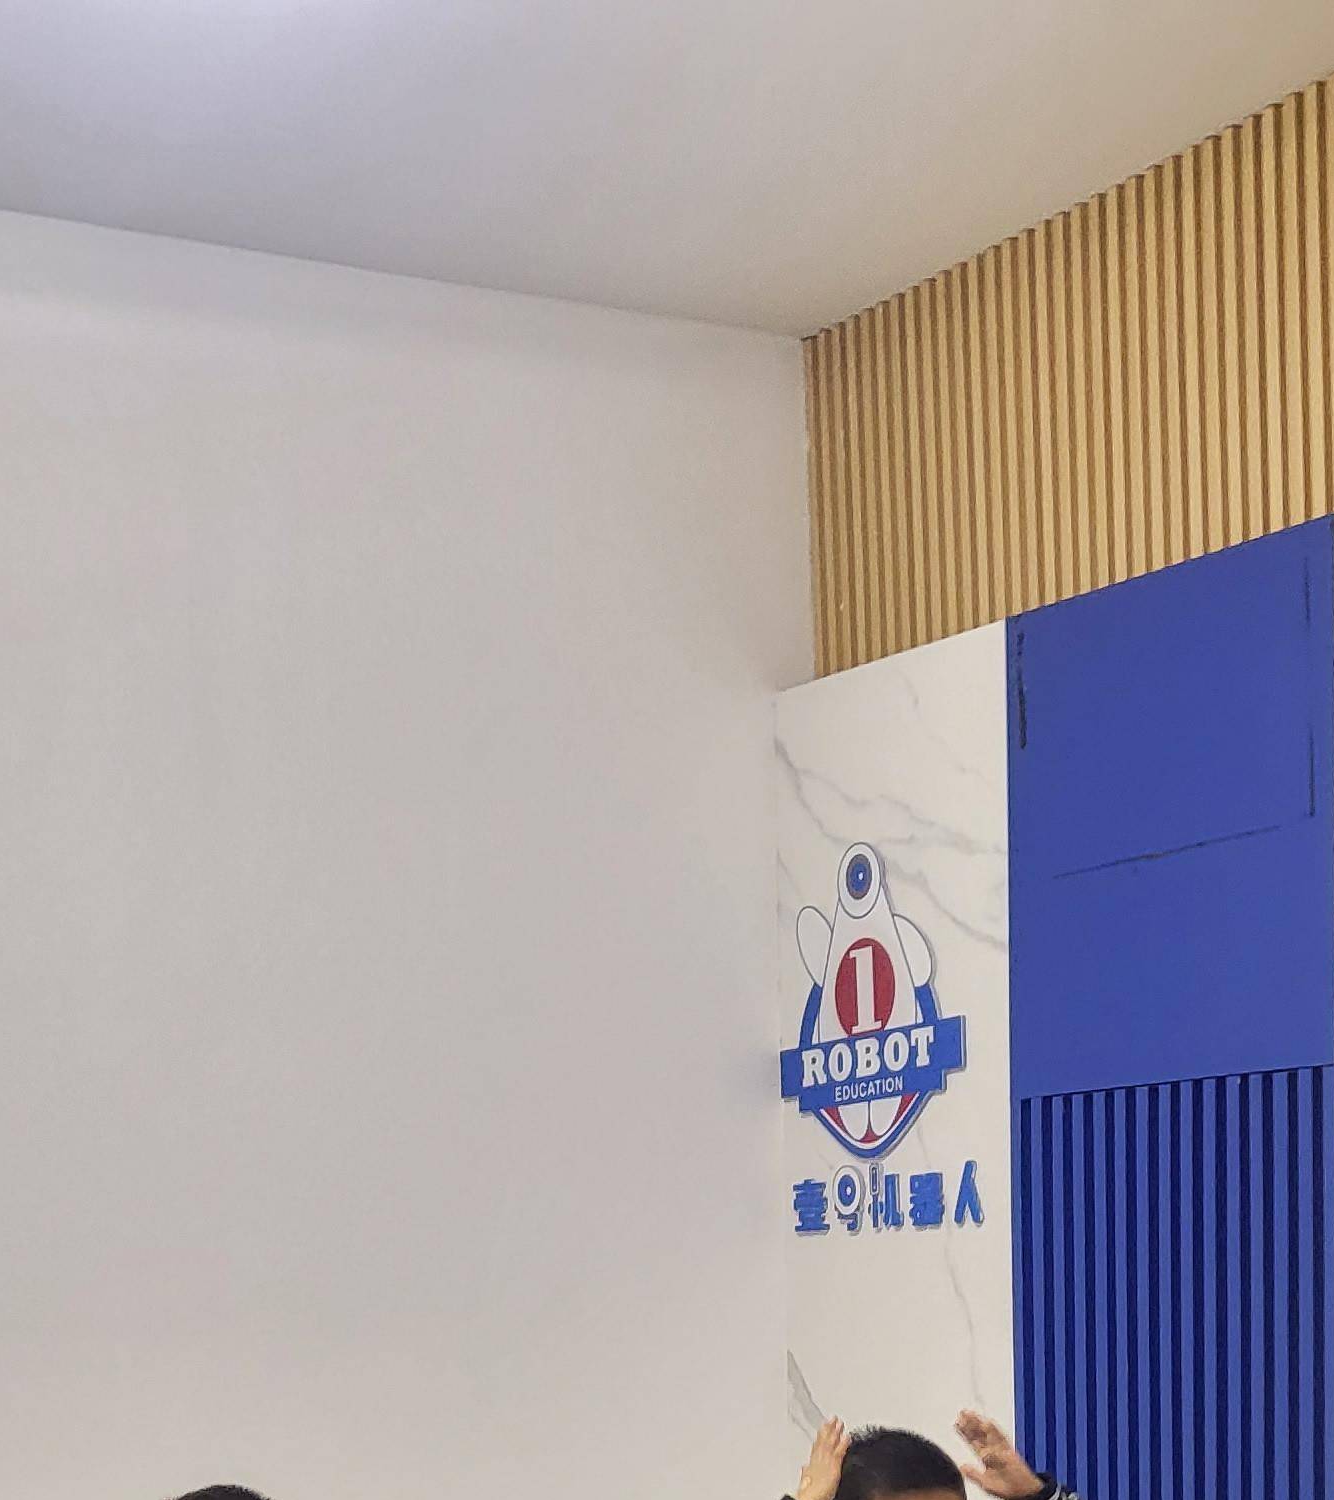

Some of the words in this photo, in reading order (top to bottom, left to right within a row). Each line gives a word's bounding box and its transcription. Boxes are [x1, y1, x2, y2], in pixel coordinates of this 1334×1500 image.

[802, 1026, 934, 1087] ROBOT
[835, 1076, 903, 1102] EDUCATION
[793, 1161, 984, 1232] 壹号机器人
